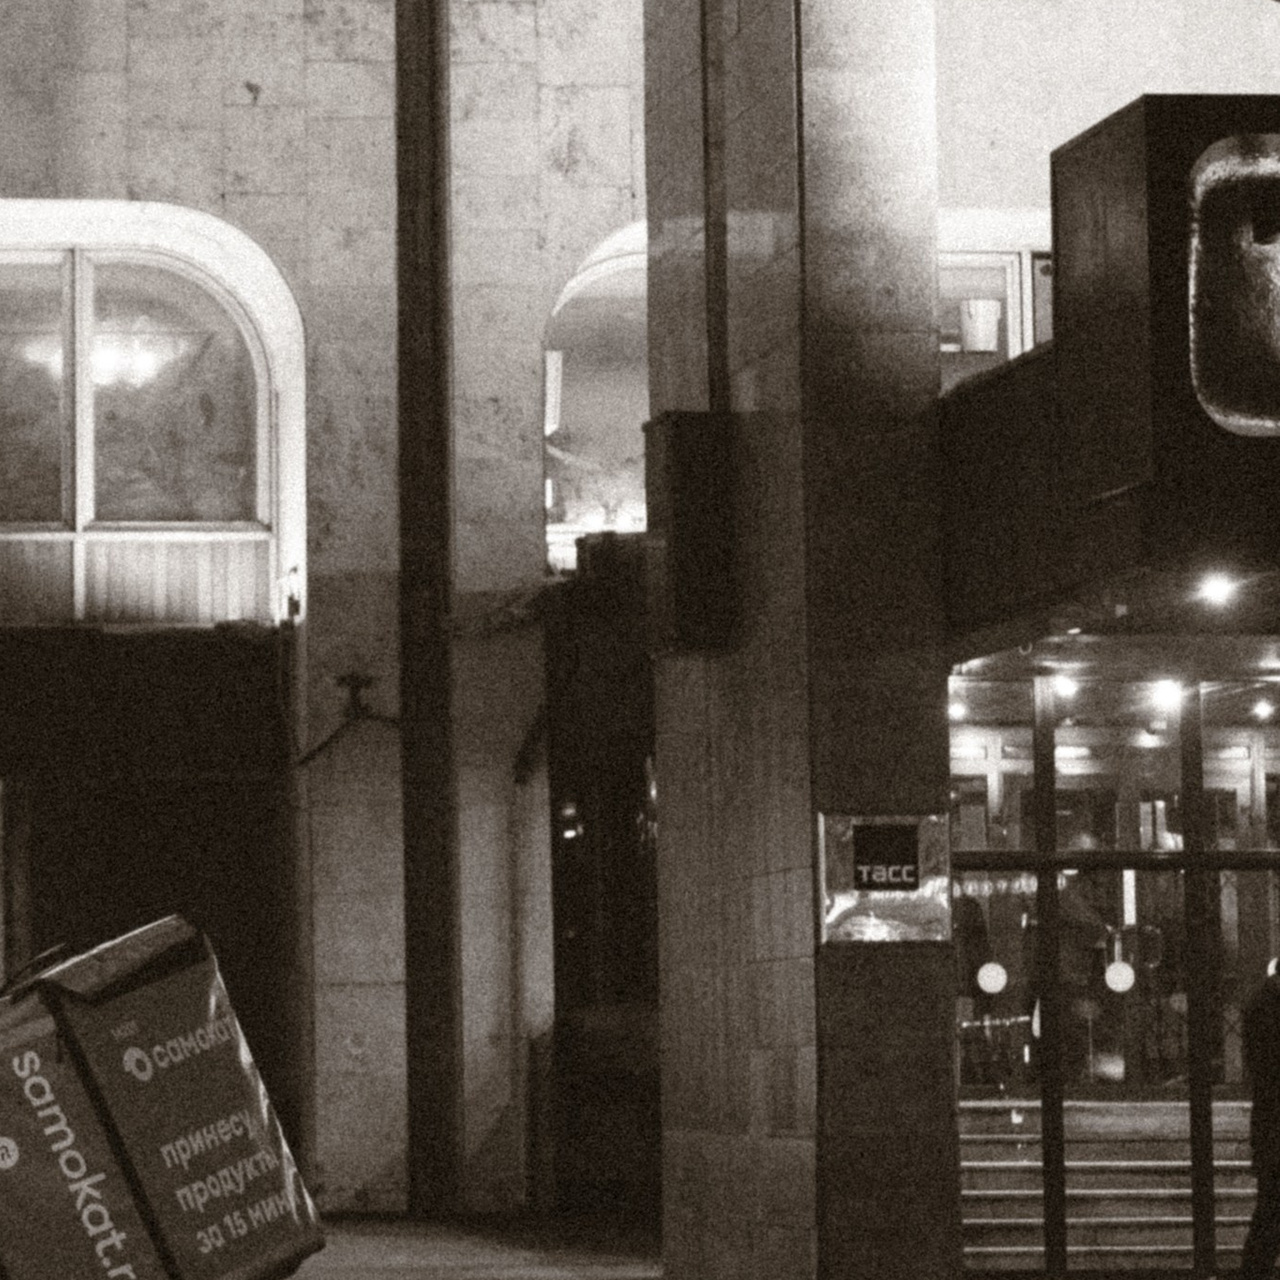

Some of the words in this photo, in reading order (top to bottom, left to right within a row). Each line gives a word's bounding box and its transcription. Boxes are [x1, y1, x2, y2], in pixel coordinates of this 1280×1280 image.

[159, 1108, 256, 1170] принесу
[175, 1148, 280, 1213] продукты
[196, 1224, 226, 1254] за
[222, 1210, 249, 1239] 15
